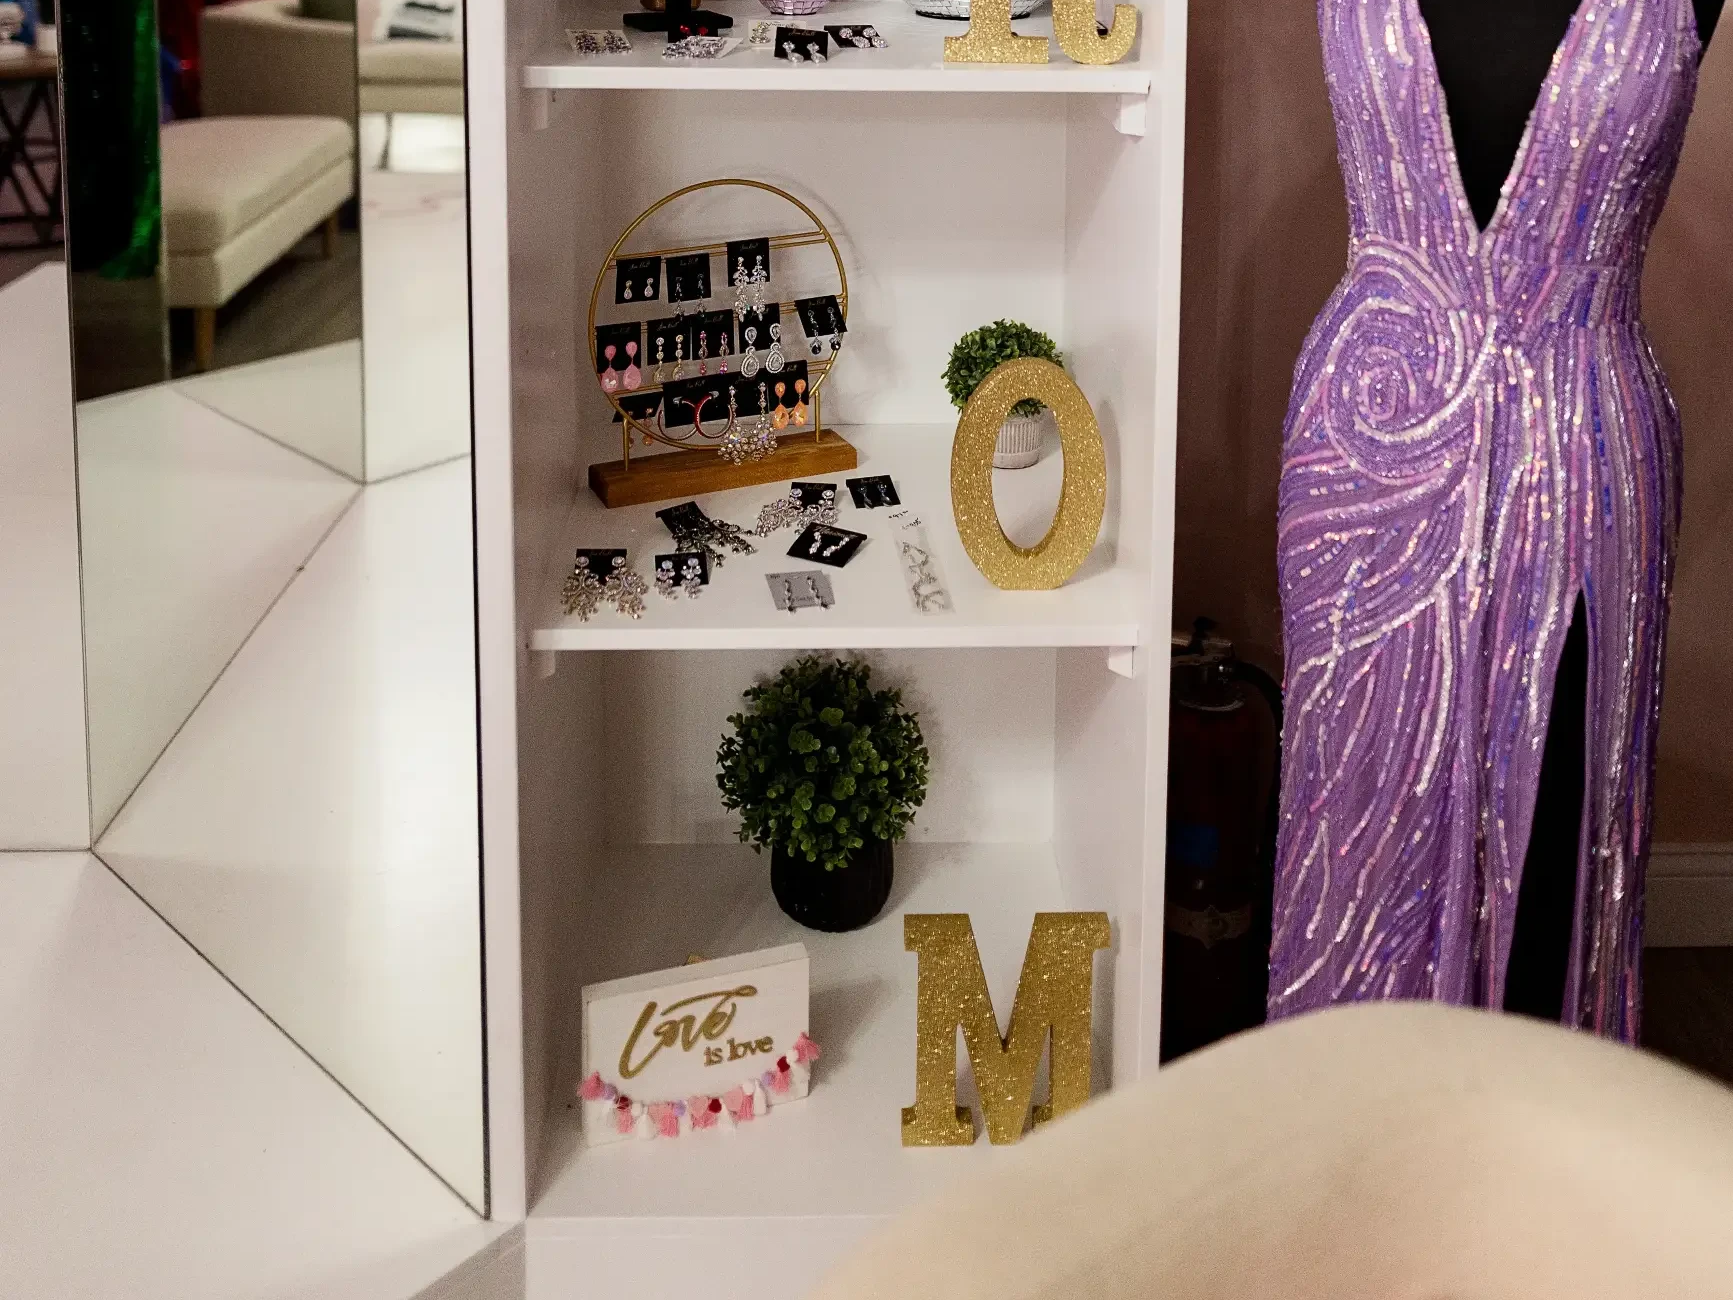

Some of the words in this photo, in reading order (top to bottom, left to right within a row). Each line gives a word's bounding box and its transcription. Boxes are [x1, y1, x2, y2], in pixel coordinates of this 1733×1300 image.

[950, 356, 1107, 590] O
[618, 984, 758, 1079] Love
[703, 1045, 723, 1067] is
[726, 1035, 774, 1062] love
[901, 912, 1111, 1147] M
